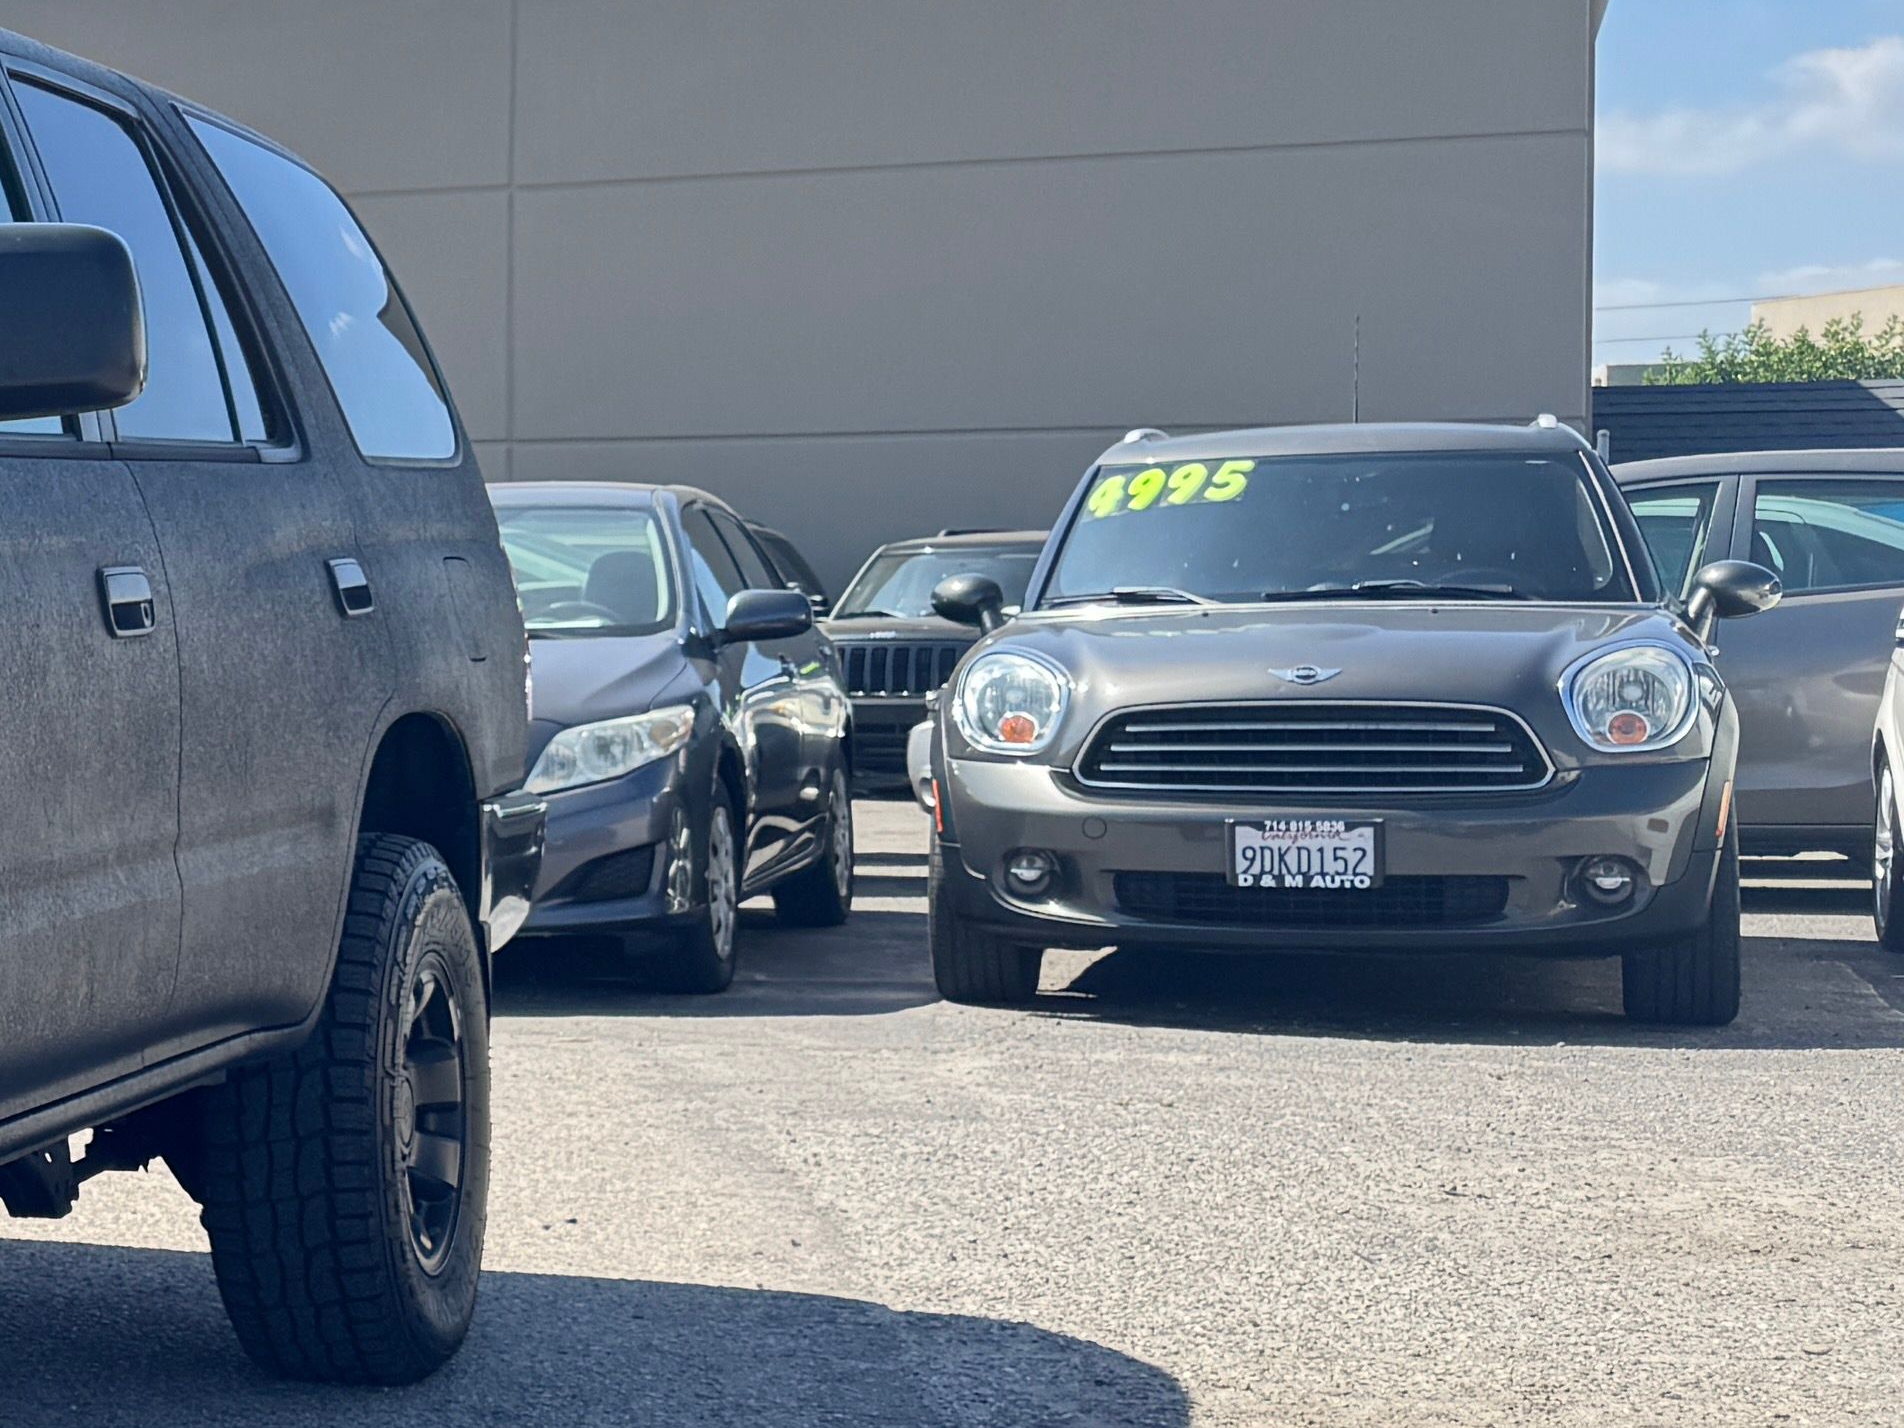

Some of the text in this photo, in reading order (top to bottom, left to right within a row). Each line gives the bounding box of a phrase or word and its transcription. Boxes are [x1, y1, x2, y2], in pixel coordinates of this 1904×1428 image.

[1241, 845, 1368, 876] 9DKD152
[1238, 874, 1371, 889] D & M AUTO
